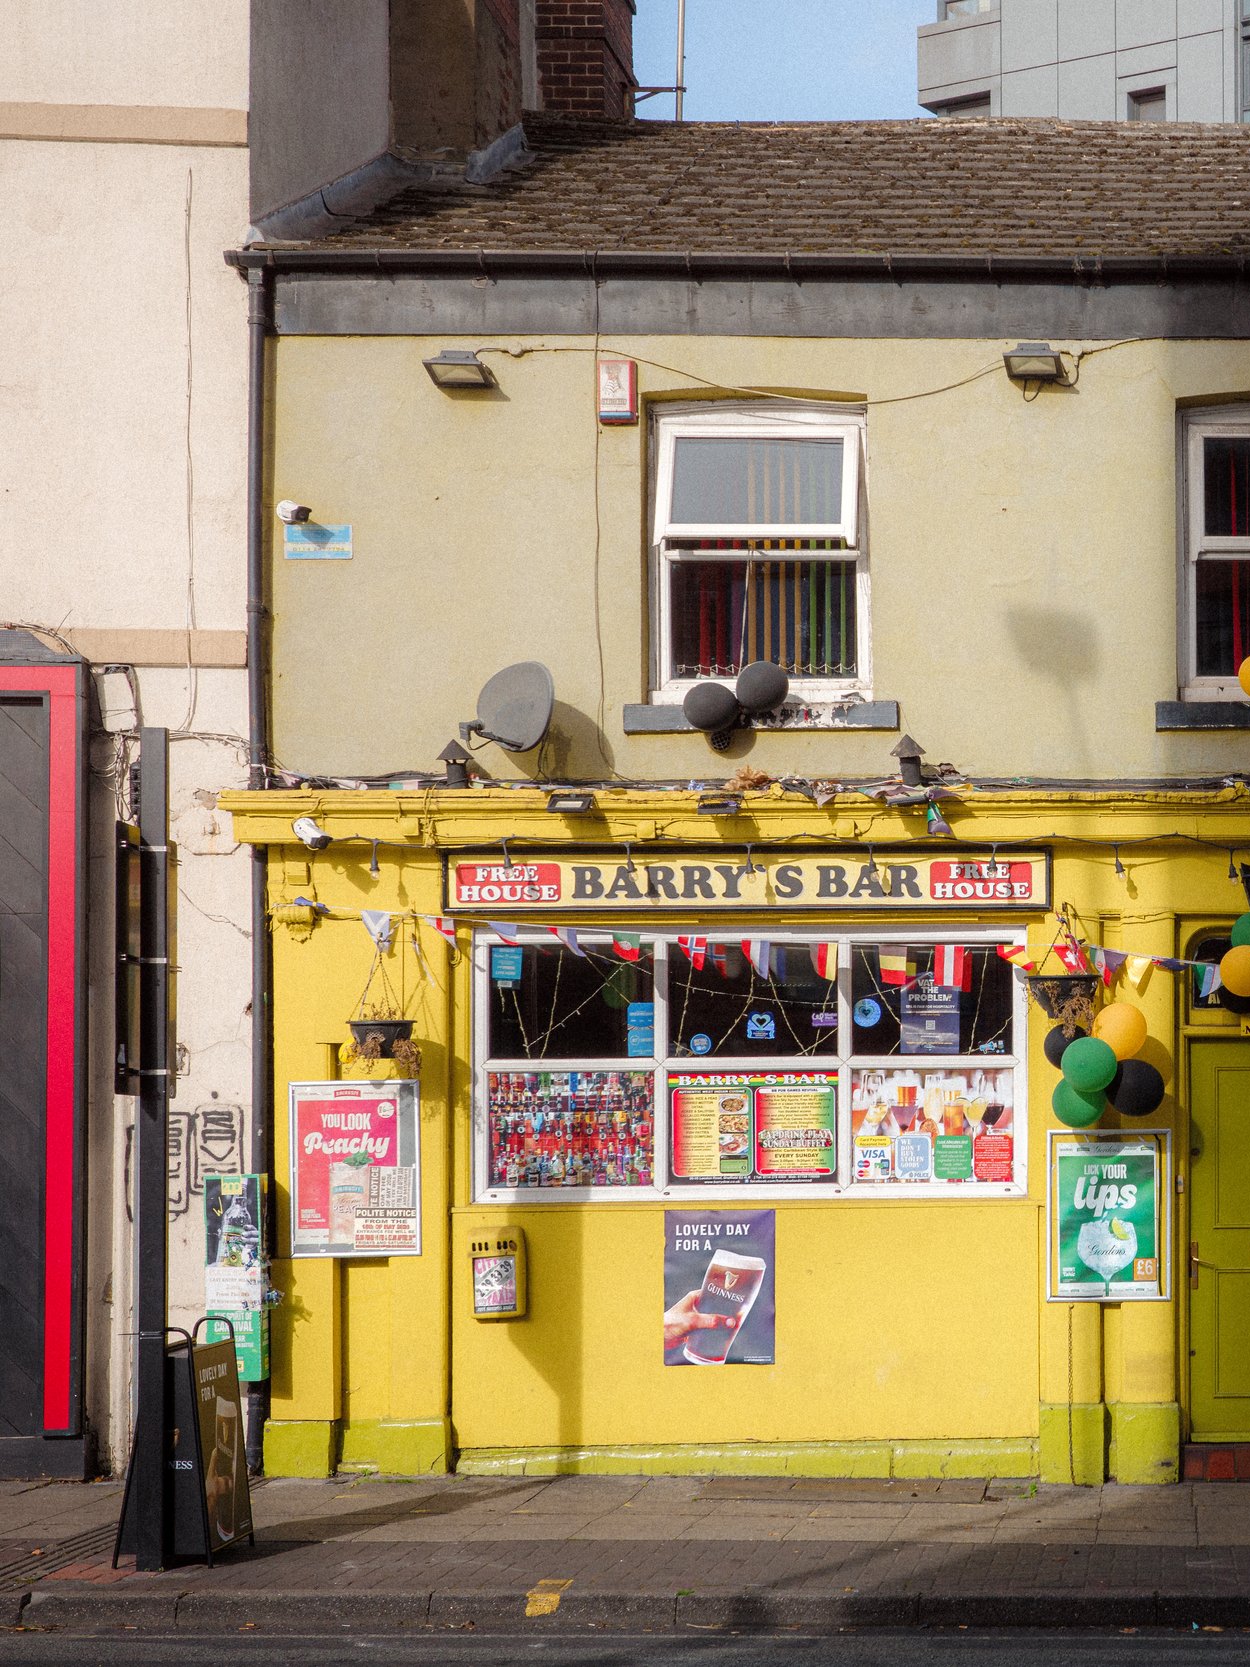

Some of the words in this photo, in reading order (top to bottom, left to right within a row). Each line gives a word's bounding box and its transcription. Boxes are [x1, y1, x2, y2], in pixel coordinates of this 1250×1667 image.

[474, 865, 540, 882] FREE
[948, 863, 1011, 880] FREE
[816, 865, 924, 898] BAR
[459, 884, 559, 902] HOUSE
[933, 882, 1031, 899] HOUSE
[921, 986, 939, 994] THE
[782, 1073, 829, 1085] BAR
[321, 1113, 341, 1129] YOU
[341, 1112, 371, 1131] LOOK
[303, 1131, 391, 1159] Peachy
[762, 1139, 795, 1148] SUNDAY
[795, 1139, 828, 1149] BUFFET
[861, 1149, 885, 1158] VISA
[1084, 1164, 1099, 1175] LICK
[1101, 1164, 1127, 1179] YOUR
[1073, 1176, 1138, 1218] lips
[356, 1209, 385, 1217] POLITE
[386, 1209, 417, 1217] NOTICE
[675, 1224, 722, 1236] LOVELY
[726, 1223, 751, 1236] DAY
[675, 1239, 700, 1251] FOR
[703, 1239, 712, 1251] A
[1136, 1259, 1153, 1275] £6
[707, 1282, 746, 1303] GUINNESS
[199, 1365, 218, 1384] LOVELY
[218, 1362, 228, 1379] DAY
[201, 1386, 212, 1403] FOR
[211, 1385, 217, 1398] A
